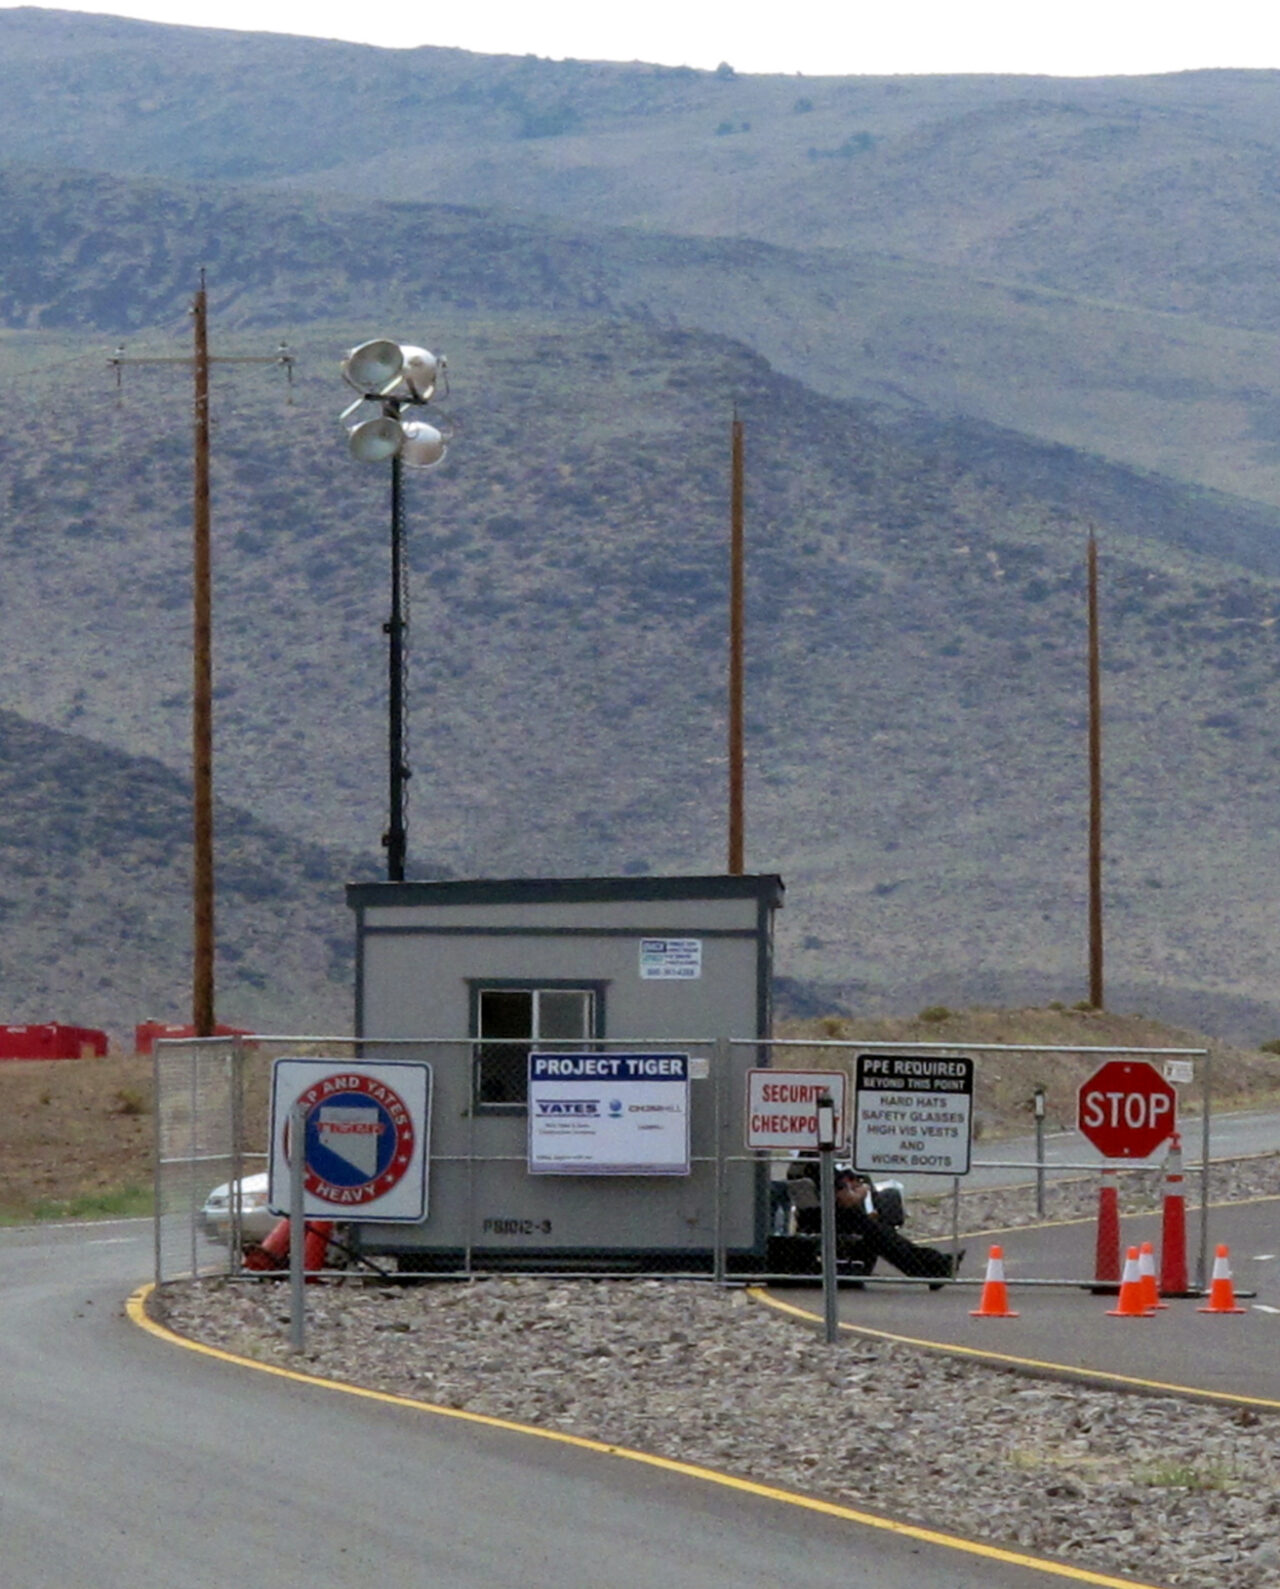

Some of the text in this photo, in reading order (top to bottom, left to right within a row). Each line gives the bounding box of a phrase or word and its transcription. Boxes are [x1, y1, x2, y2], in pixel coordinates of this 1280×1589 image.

[535, 1059, 684, 1076] PROJECT TIGER
[863, 1059, 967, 1077] PPE REQUIRED
[863, 1077, 966, 1090] BEYOND THIS POINT
[323, 1076, 408, 1126] AND YATES
[880, 1096, 948, 1108] HARD HATS
[538, 1104, 598, 1113] YATES
[1084, 1091, 1171, 1129] STOP
[862, 1110, 965, 1123] SAFETY GLASSES
[751, 1114, 840, 1134] CHECKPOT
[866, 1125, 959, 1138] HIGH VIS VESTS
[899, 1140, 926, 1151] AND
[871, 1154, 953, 1167] WORK BOOTS
[315, 1183, 377, 1202] HEAVY
